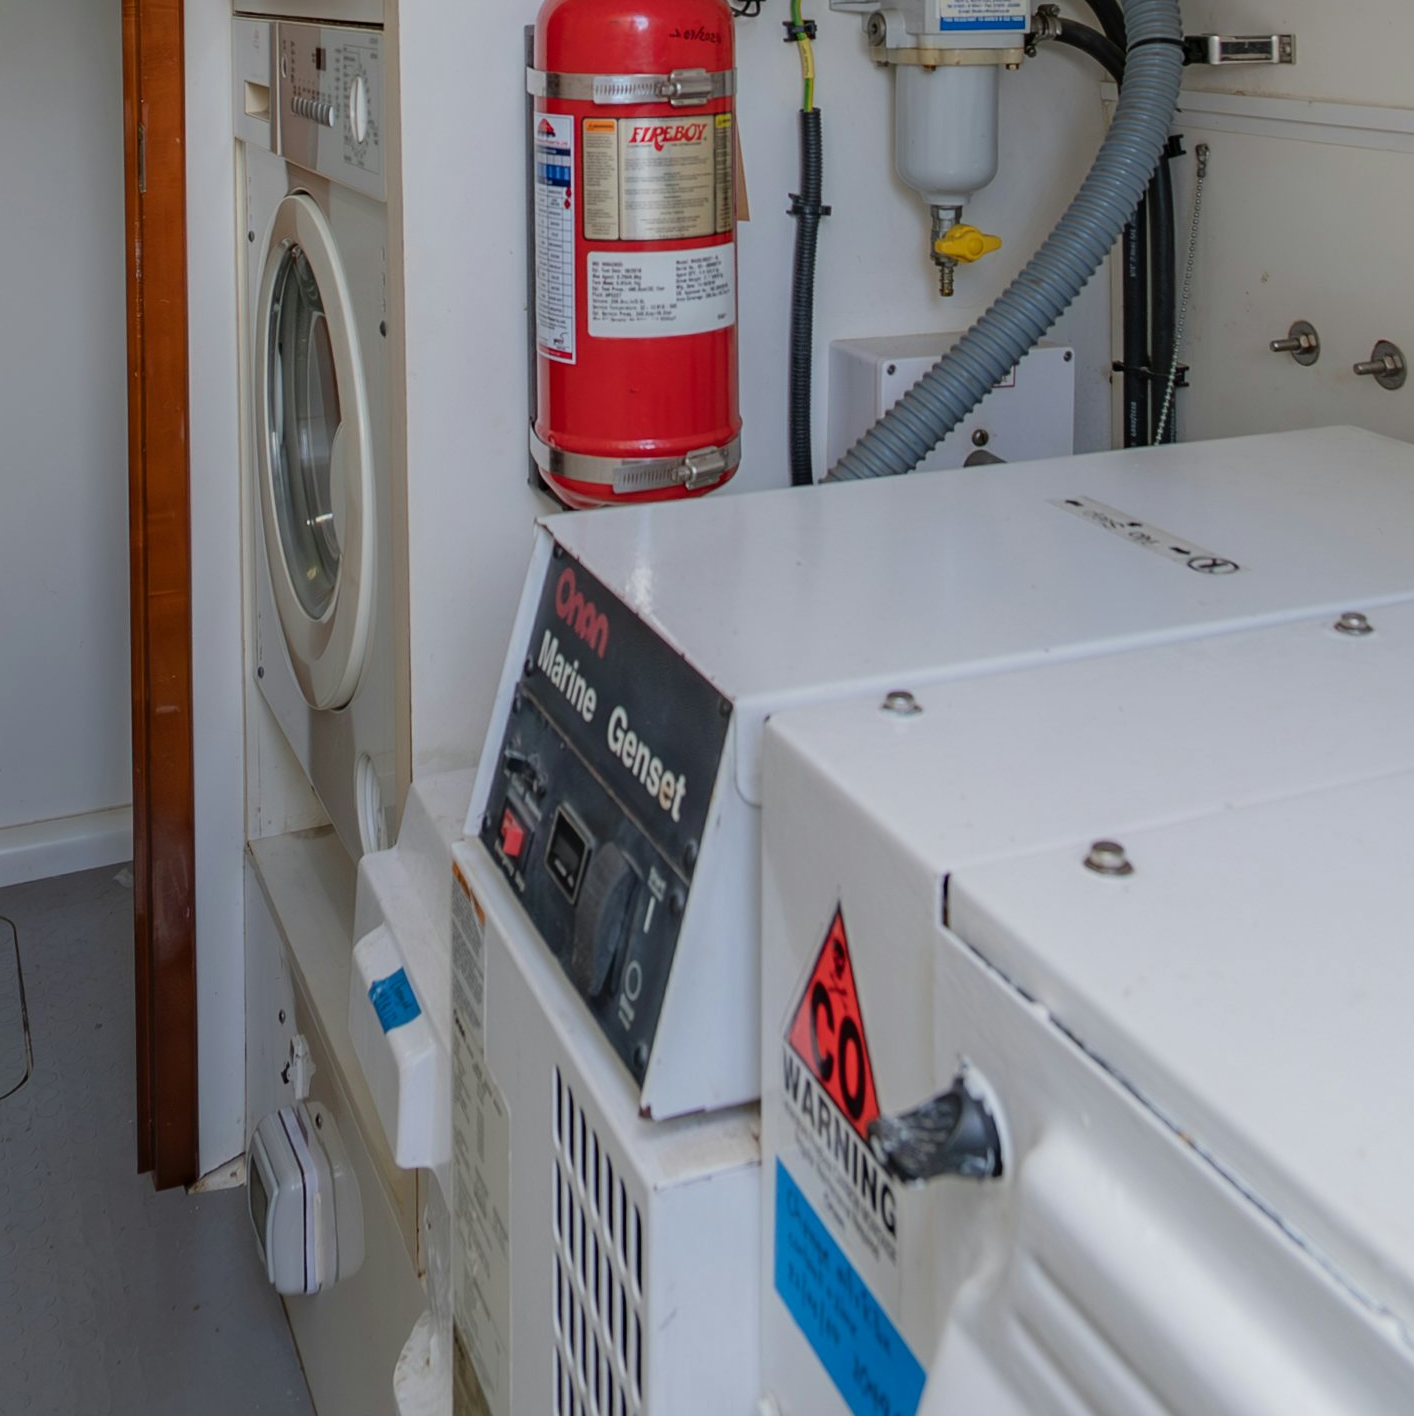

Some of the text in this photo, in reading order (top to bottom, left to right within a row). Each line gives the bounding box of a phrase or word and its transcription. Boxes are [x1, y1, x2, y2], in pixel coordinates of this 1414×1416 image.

[628, 123, 708, 152] FIREBOY
[554, 567, 610, 659] Onan
[537, 629, 687, 824] Marine Genset
[808, 979, 866, 1122] CO
[782, 1044, 898, 1239] WARNING
